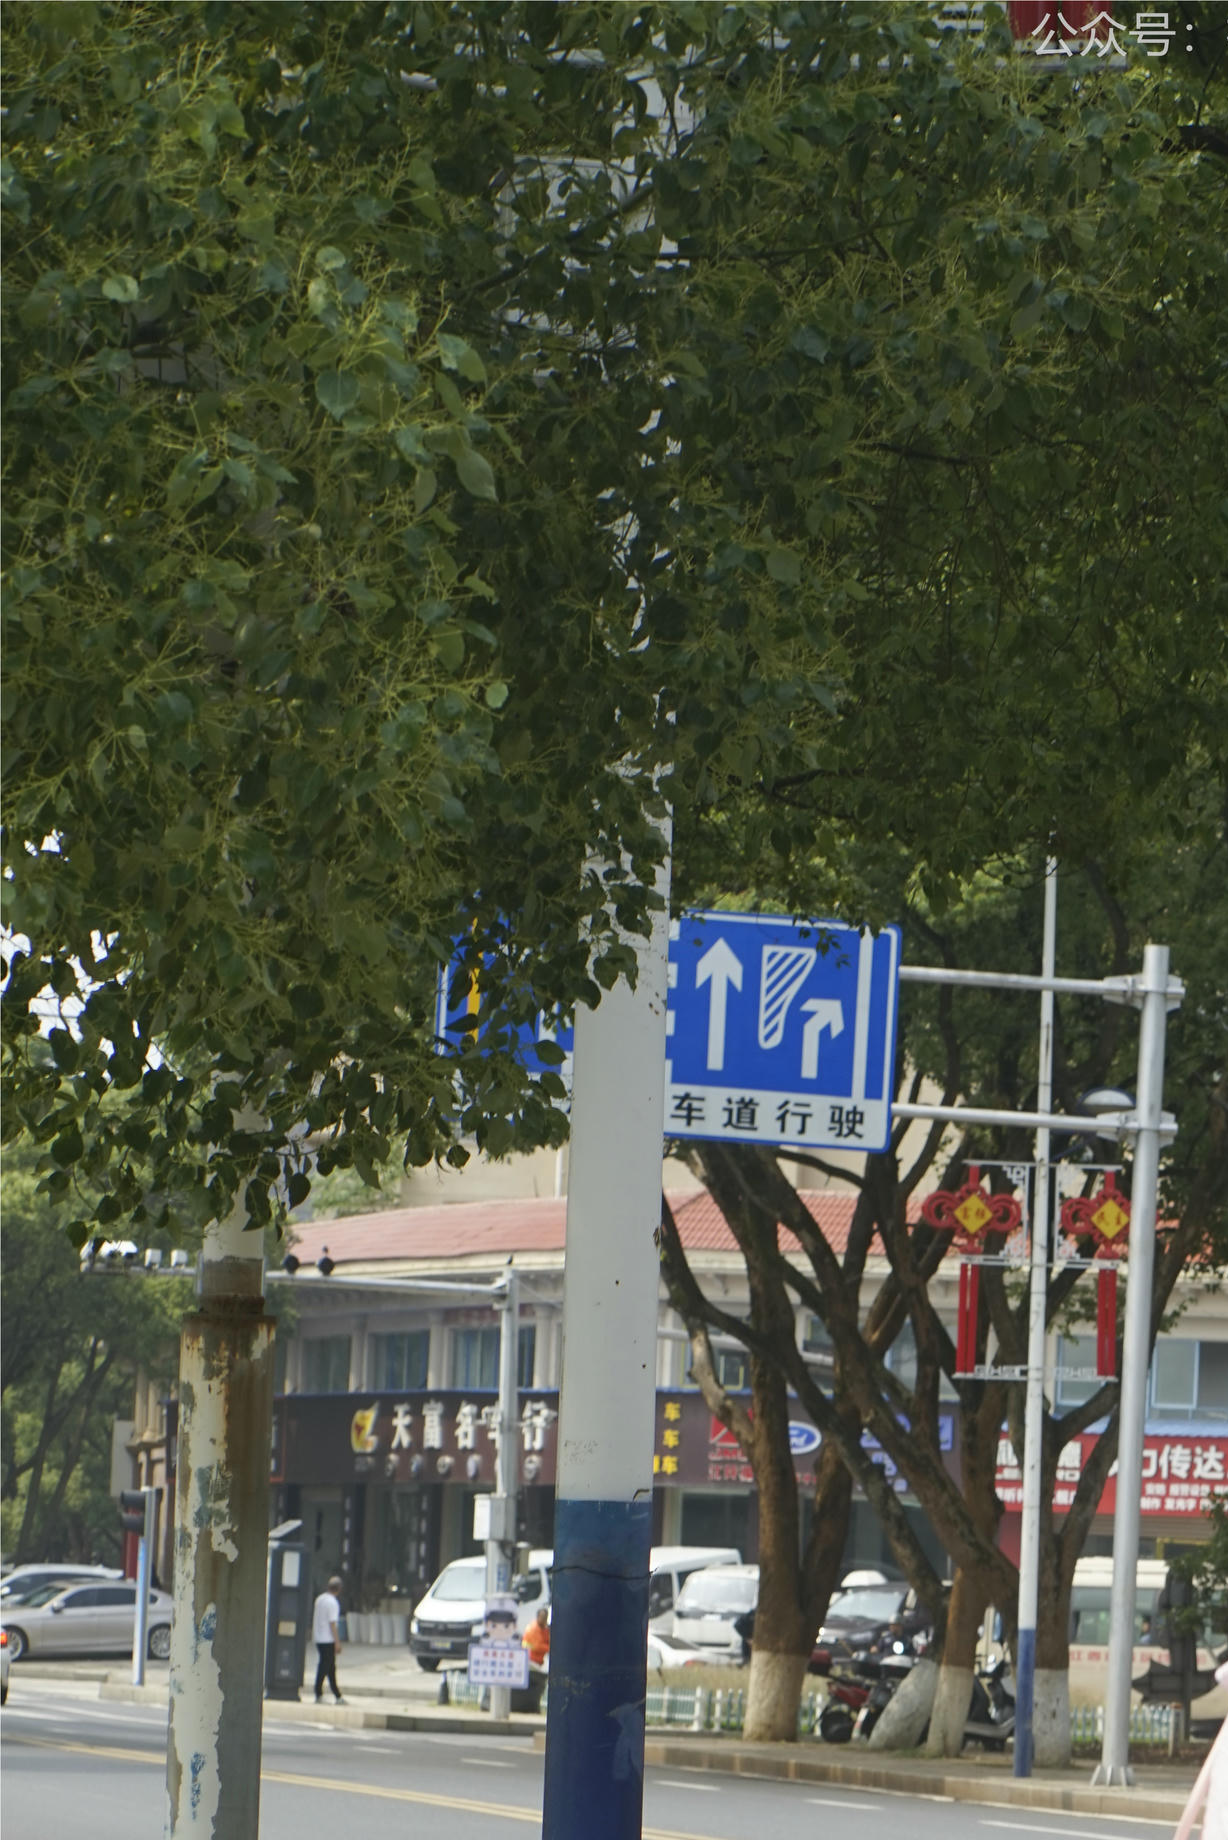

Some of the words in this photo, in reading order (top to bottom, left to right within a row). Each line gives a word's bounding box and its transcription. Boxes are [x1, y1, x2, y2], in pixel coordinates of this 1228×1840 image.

[671, 1091, 864, 1139] 车道行驶
[653, 1454, 679, 1475] 车
